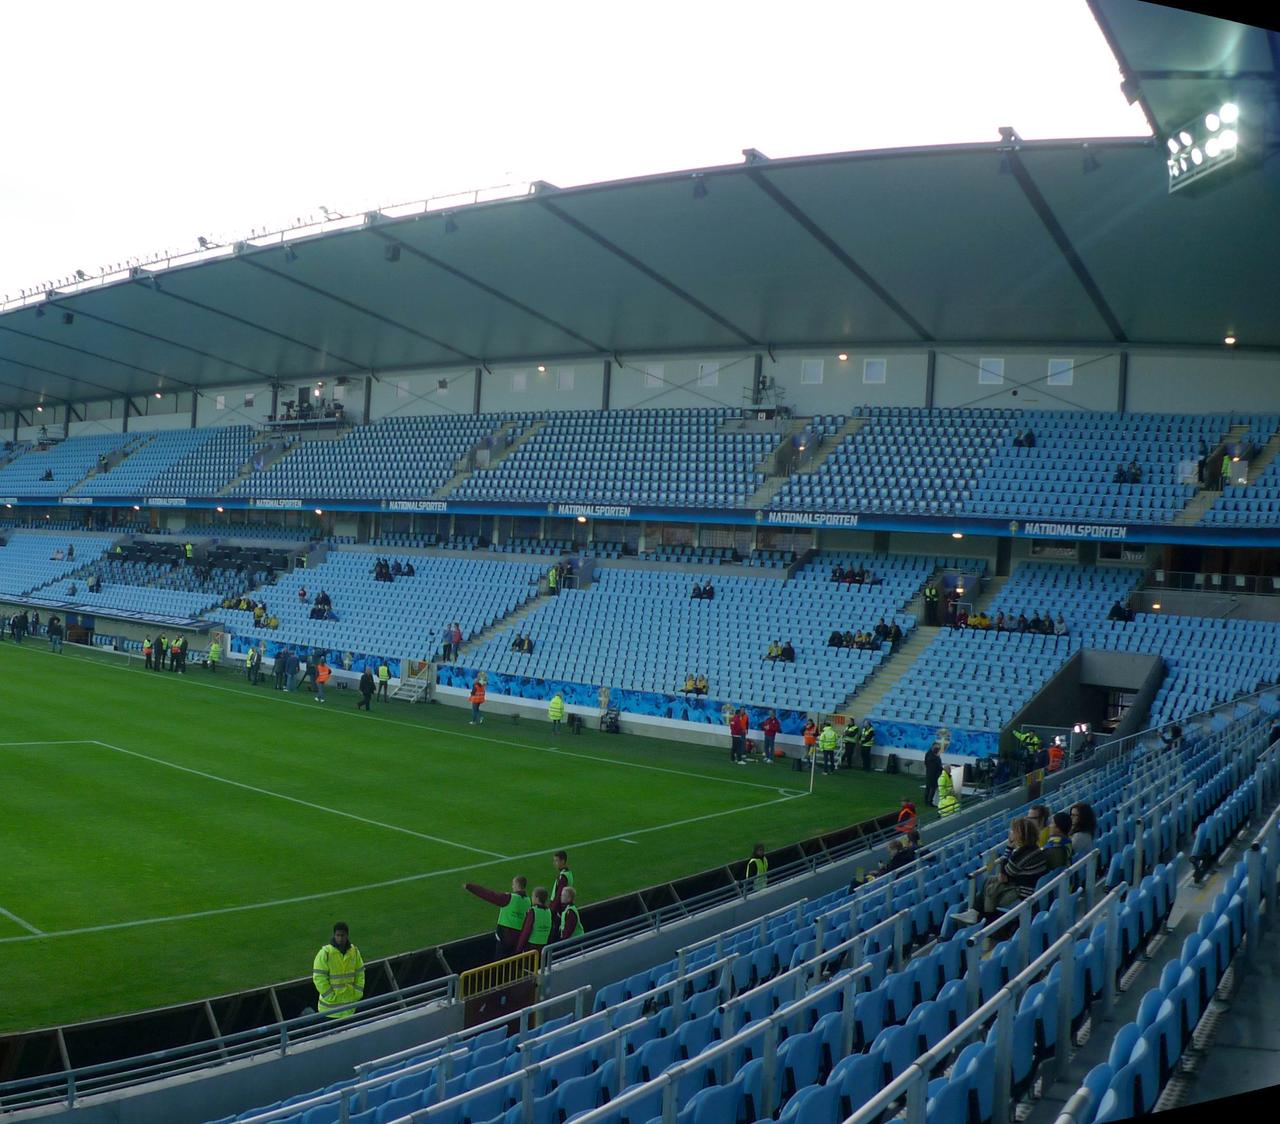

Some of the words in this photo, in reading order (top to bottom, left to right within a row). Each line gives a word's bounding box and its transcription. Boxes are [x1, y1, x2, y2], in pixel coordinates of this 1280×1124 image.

[389, 501, 447, 511] NATIONALSPORTEN
[558, 505, 631, 517] NATIONALSPORTEN
[768, 511, 858, 526] NATIONALSPORTEN
[1024, 522, 1127, 539] NATIONALSPORTEN
